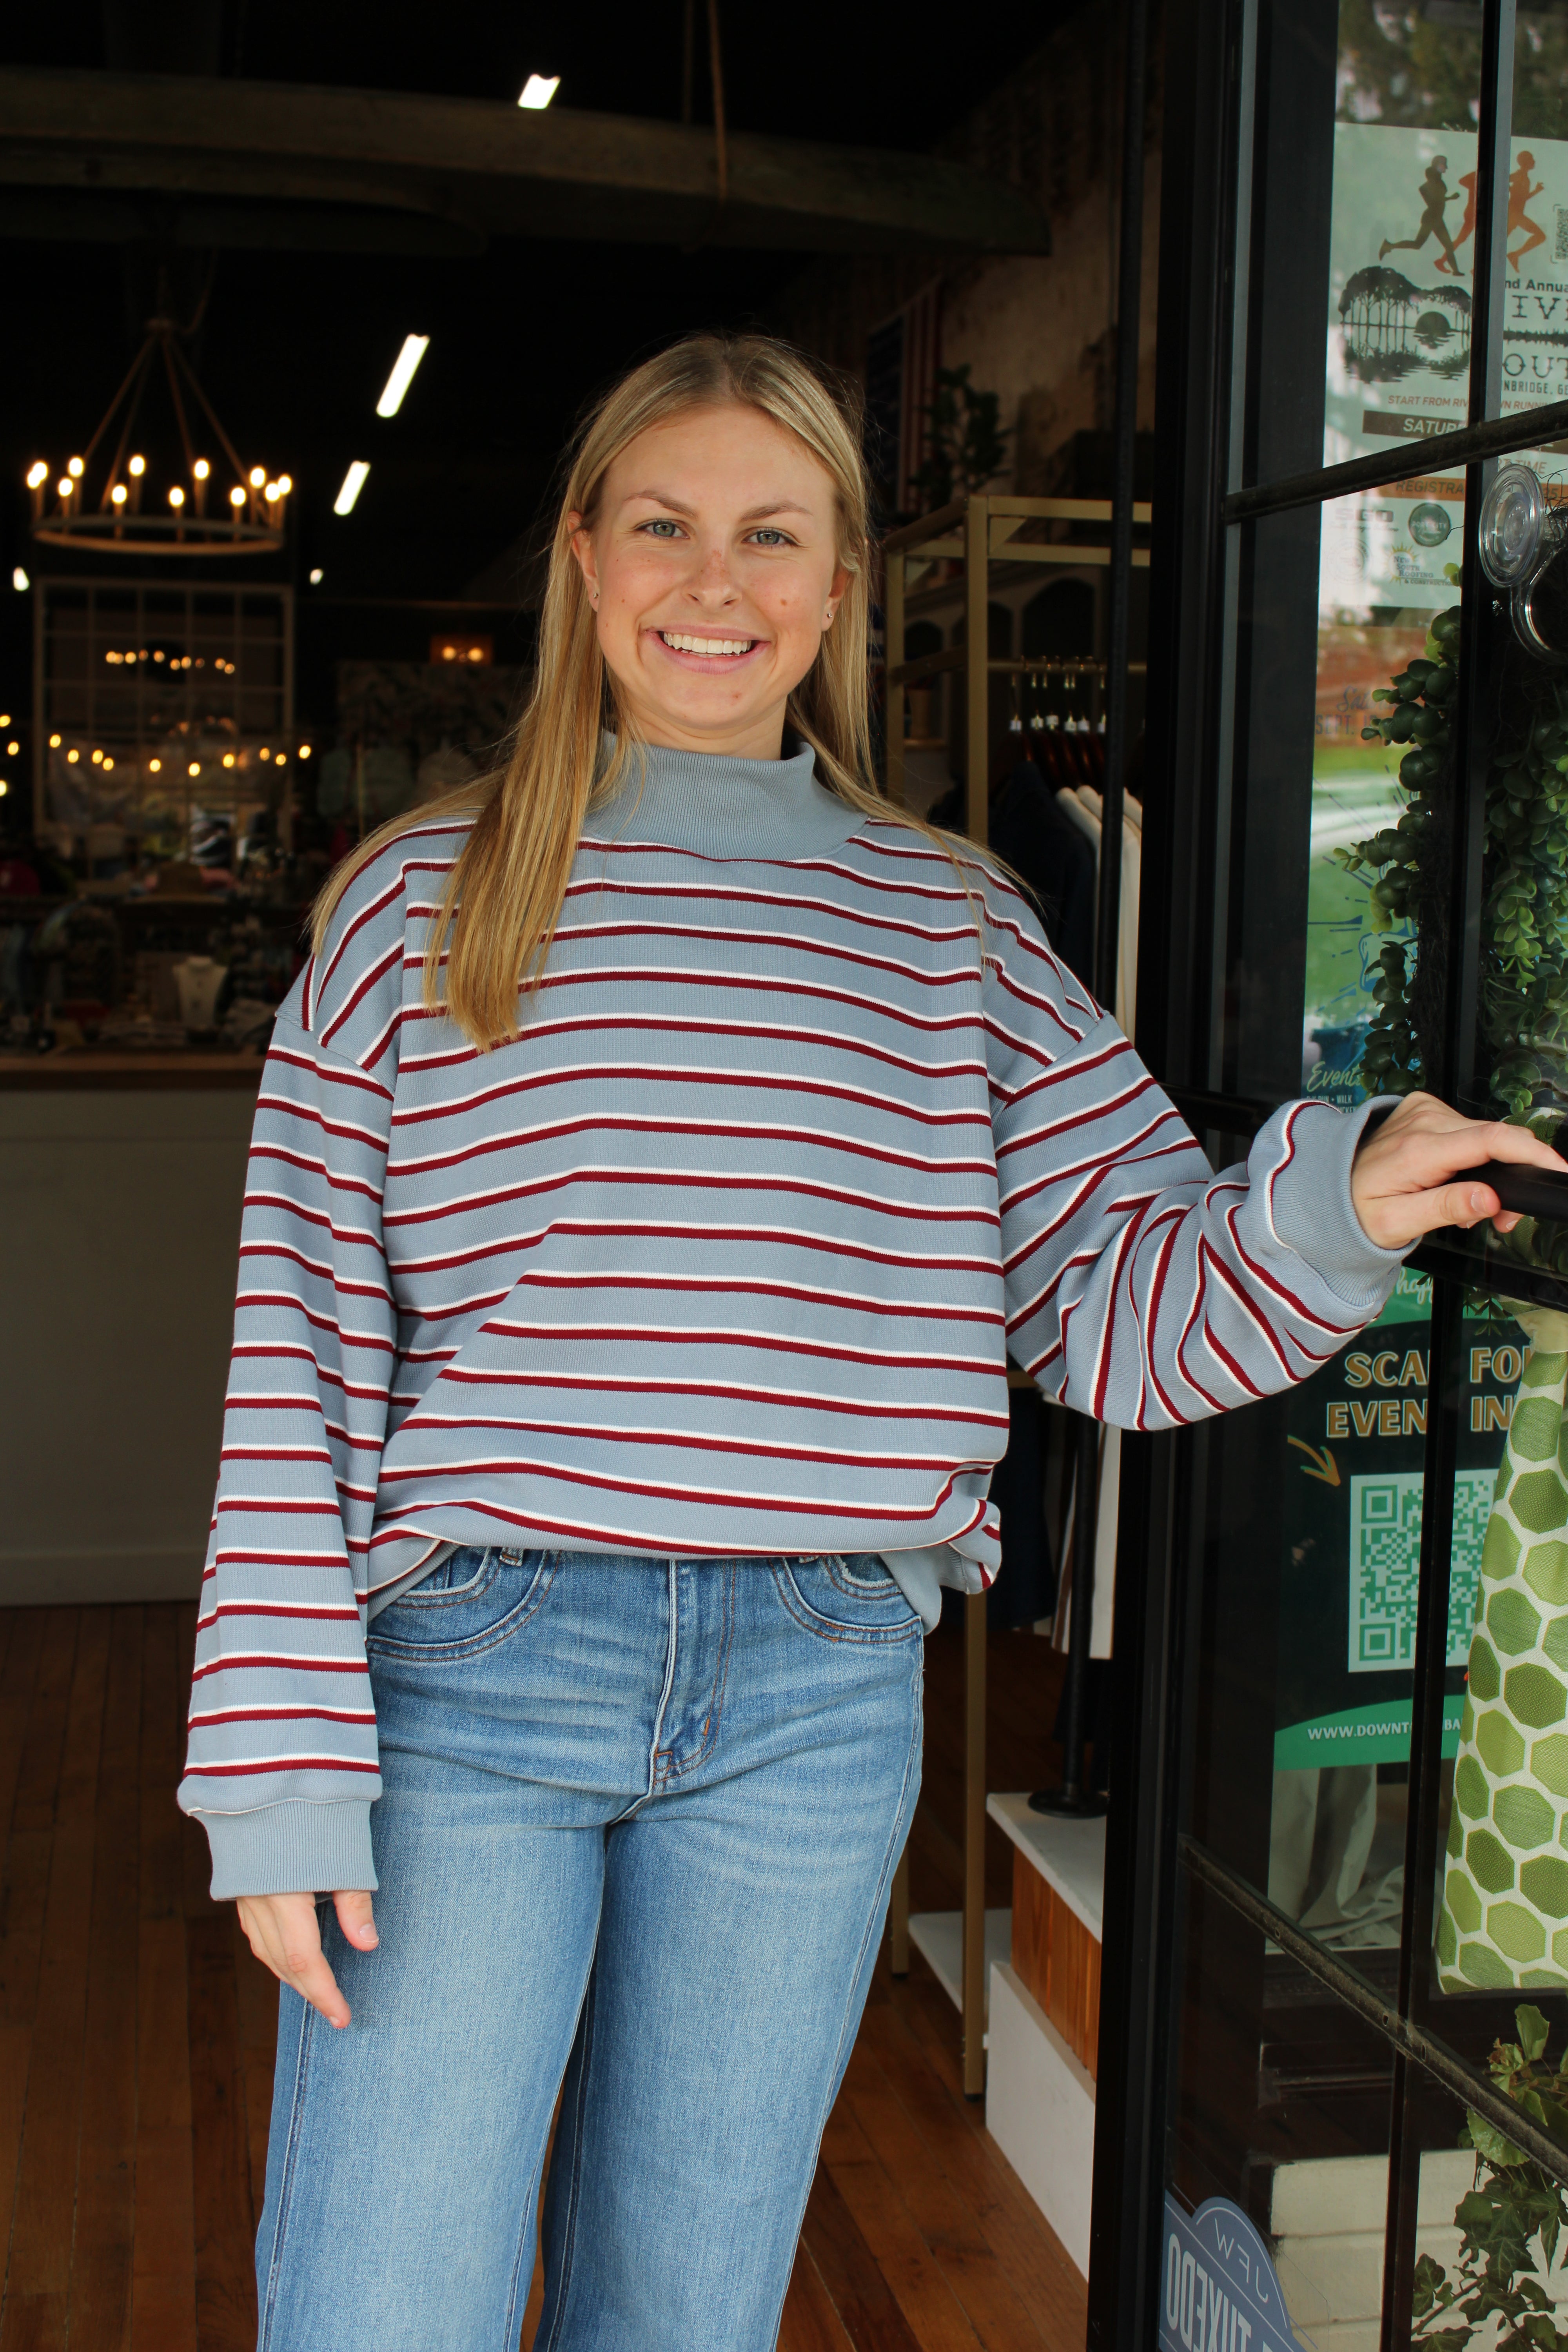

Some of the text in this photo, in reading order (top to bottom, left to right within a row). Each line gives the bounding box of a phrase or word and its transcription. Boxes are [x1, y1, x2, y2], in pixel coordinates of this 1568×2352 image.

[1512, 295, 1568, 321] IV
[1388, 395, 1420, 405] START
[1422, 397, 1450, 406] FROM
[1336, 1095, 1352, 1104] WALK
[1345, 1350, 1430, 1388] SCA
[1471, 1395, 1517, 1432] IN
